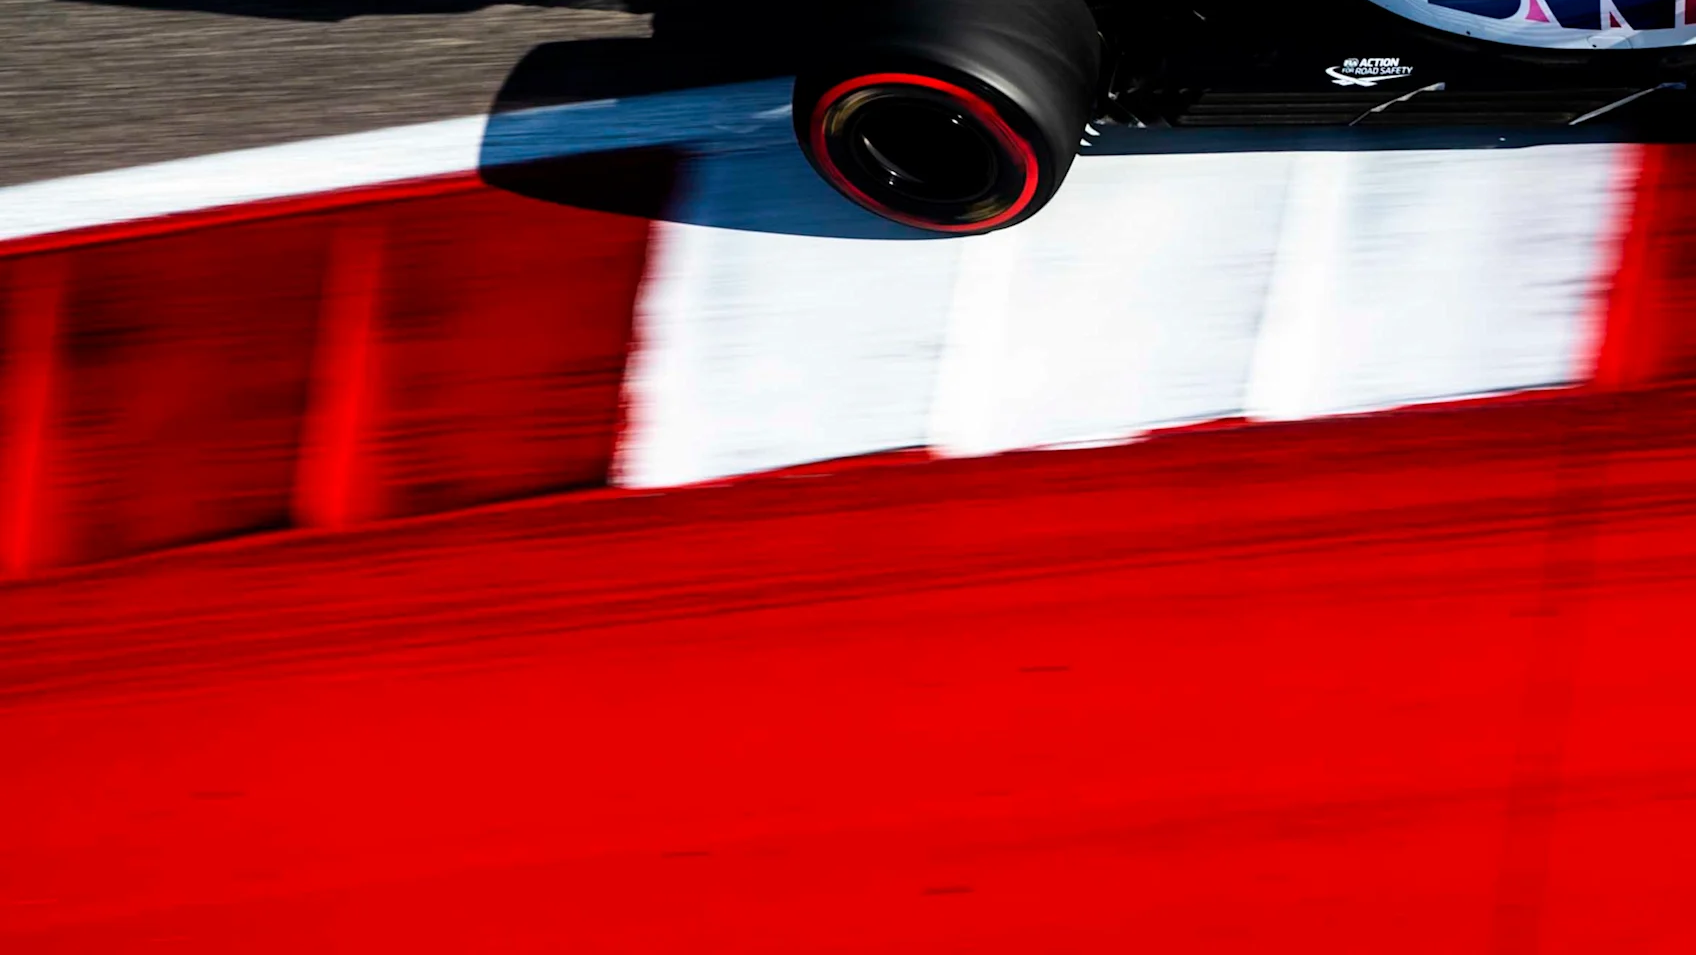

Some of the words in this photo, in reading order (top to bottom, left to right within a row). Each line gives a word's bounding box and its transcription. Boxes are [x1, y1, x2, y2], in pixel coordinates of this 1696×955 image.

[1359, 58, 1399, 67] ACTION
[1355, 67, 1379, 75] ROAD
[1380, 66, 1413, 74] SAFETY
